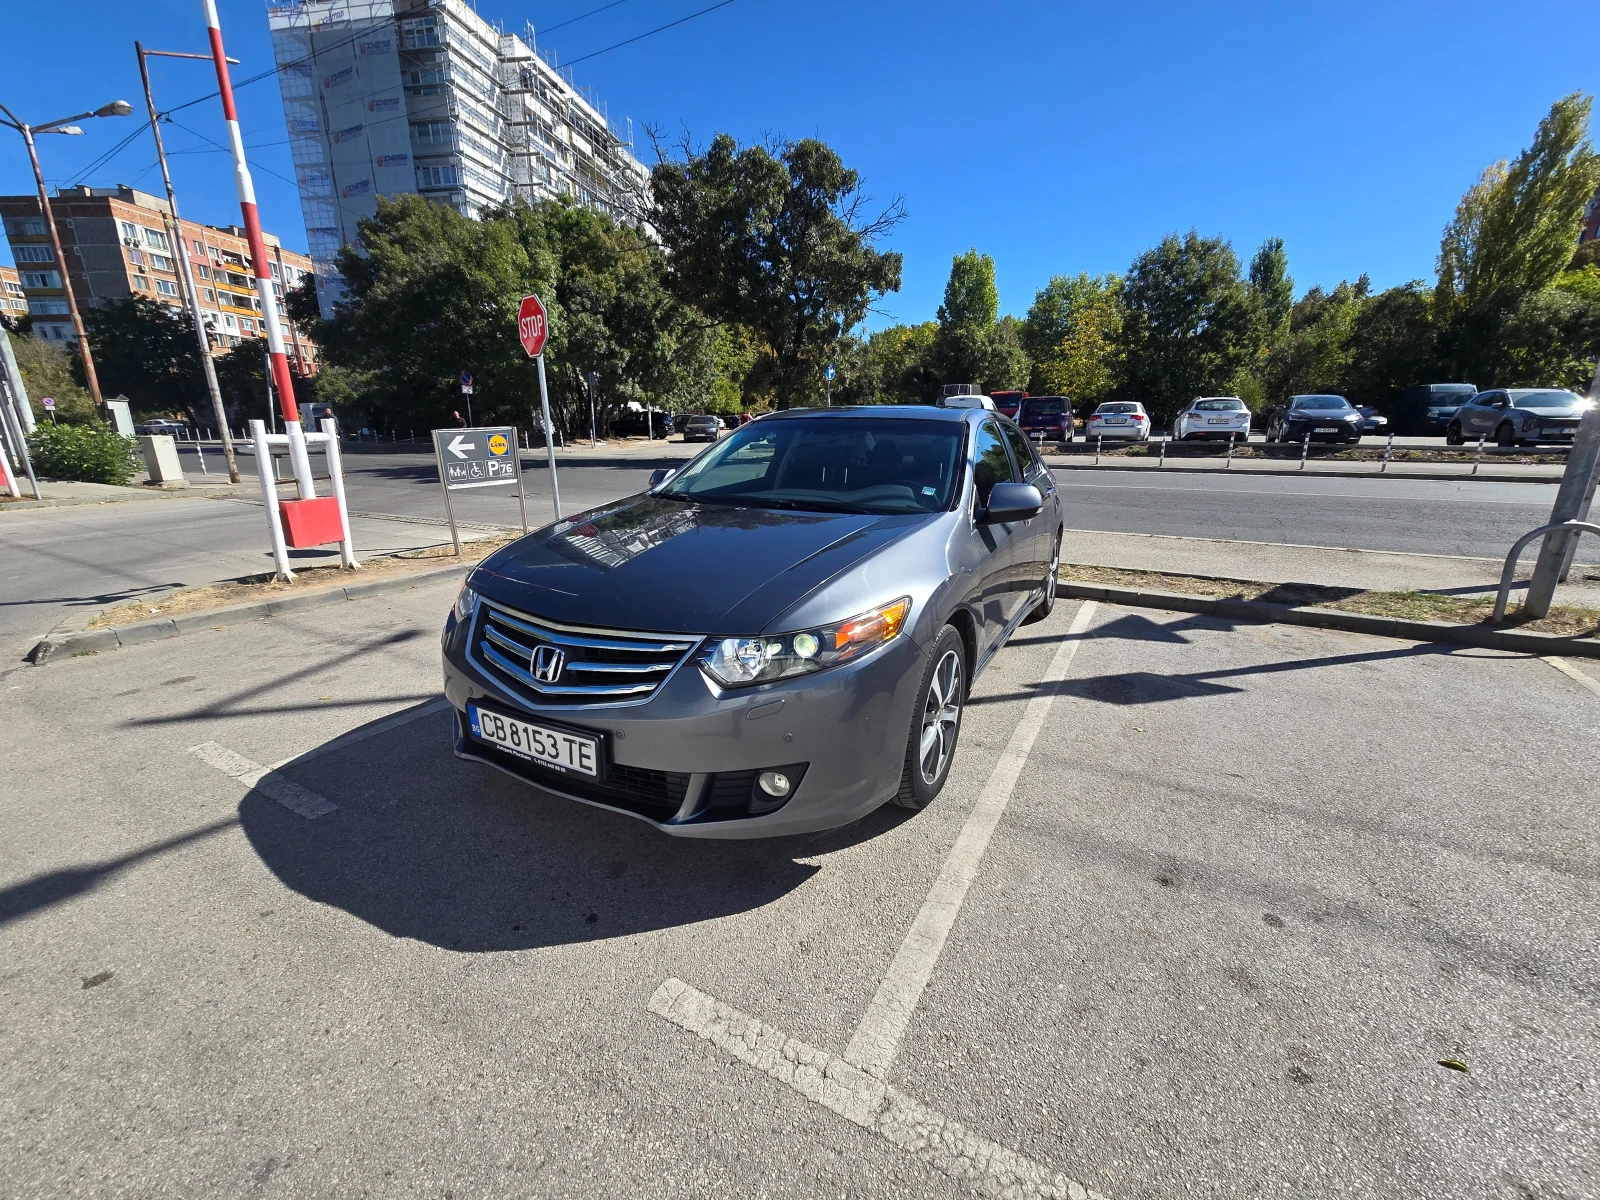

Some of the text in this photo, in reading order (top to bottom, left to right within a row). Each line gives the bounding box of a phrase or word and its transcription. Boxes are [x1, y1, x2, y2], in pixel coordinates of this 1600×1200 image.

[521, 314, 543, 339] STOP
[488, 460, 513, 477] P 76
[481, 712, 593, 772] CB 8153 TE
